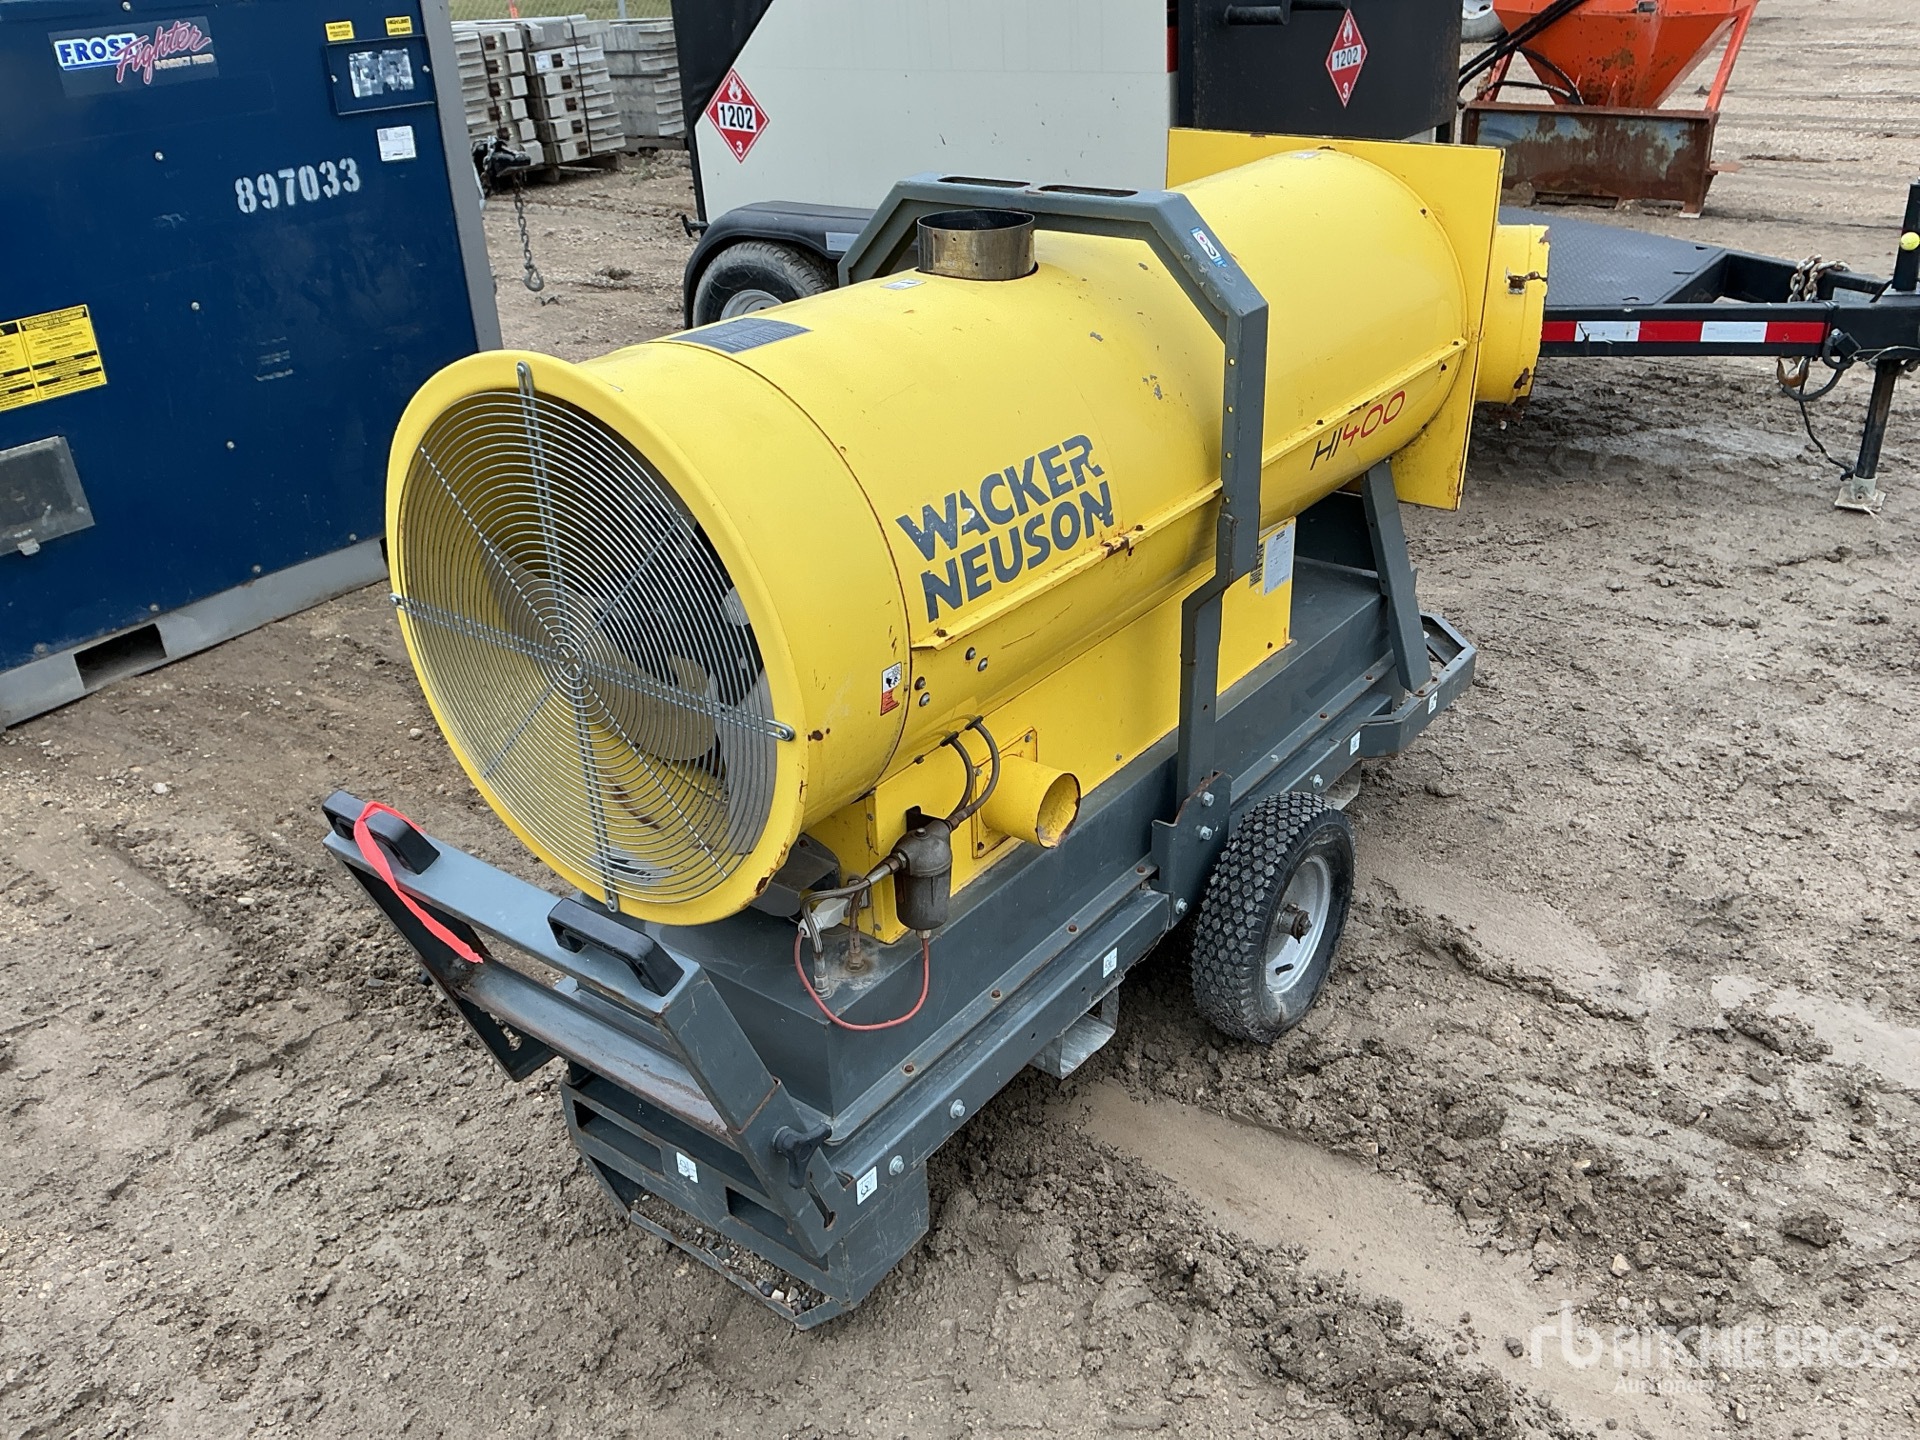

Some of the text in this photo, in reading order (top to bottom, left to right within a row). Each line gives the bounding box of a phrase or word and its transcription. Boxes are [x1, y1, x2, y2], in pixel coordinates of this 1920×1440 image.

[57, 20, 212, 84] FROST Fighter
[1335, 47, 1358, 68] 1202
[1342, 82, 1349, 98] 3
[720, 104, 754, 130] 1202
[735, 141, 743, 153] 3
[235, 157, 361, 213] 897033
[895, 434, 1105, 561] WACKER
[920, 480, 1115, 623] NEUSON
